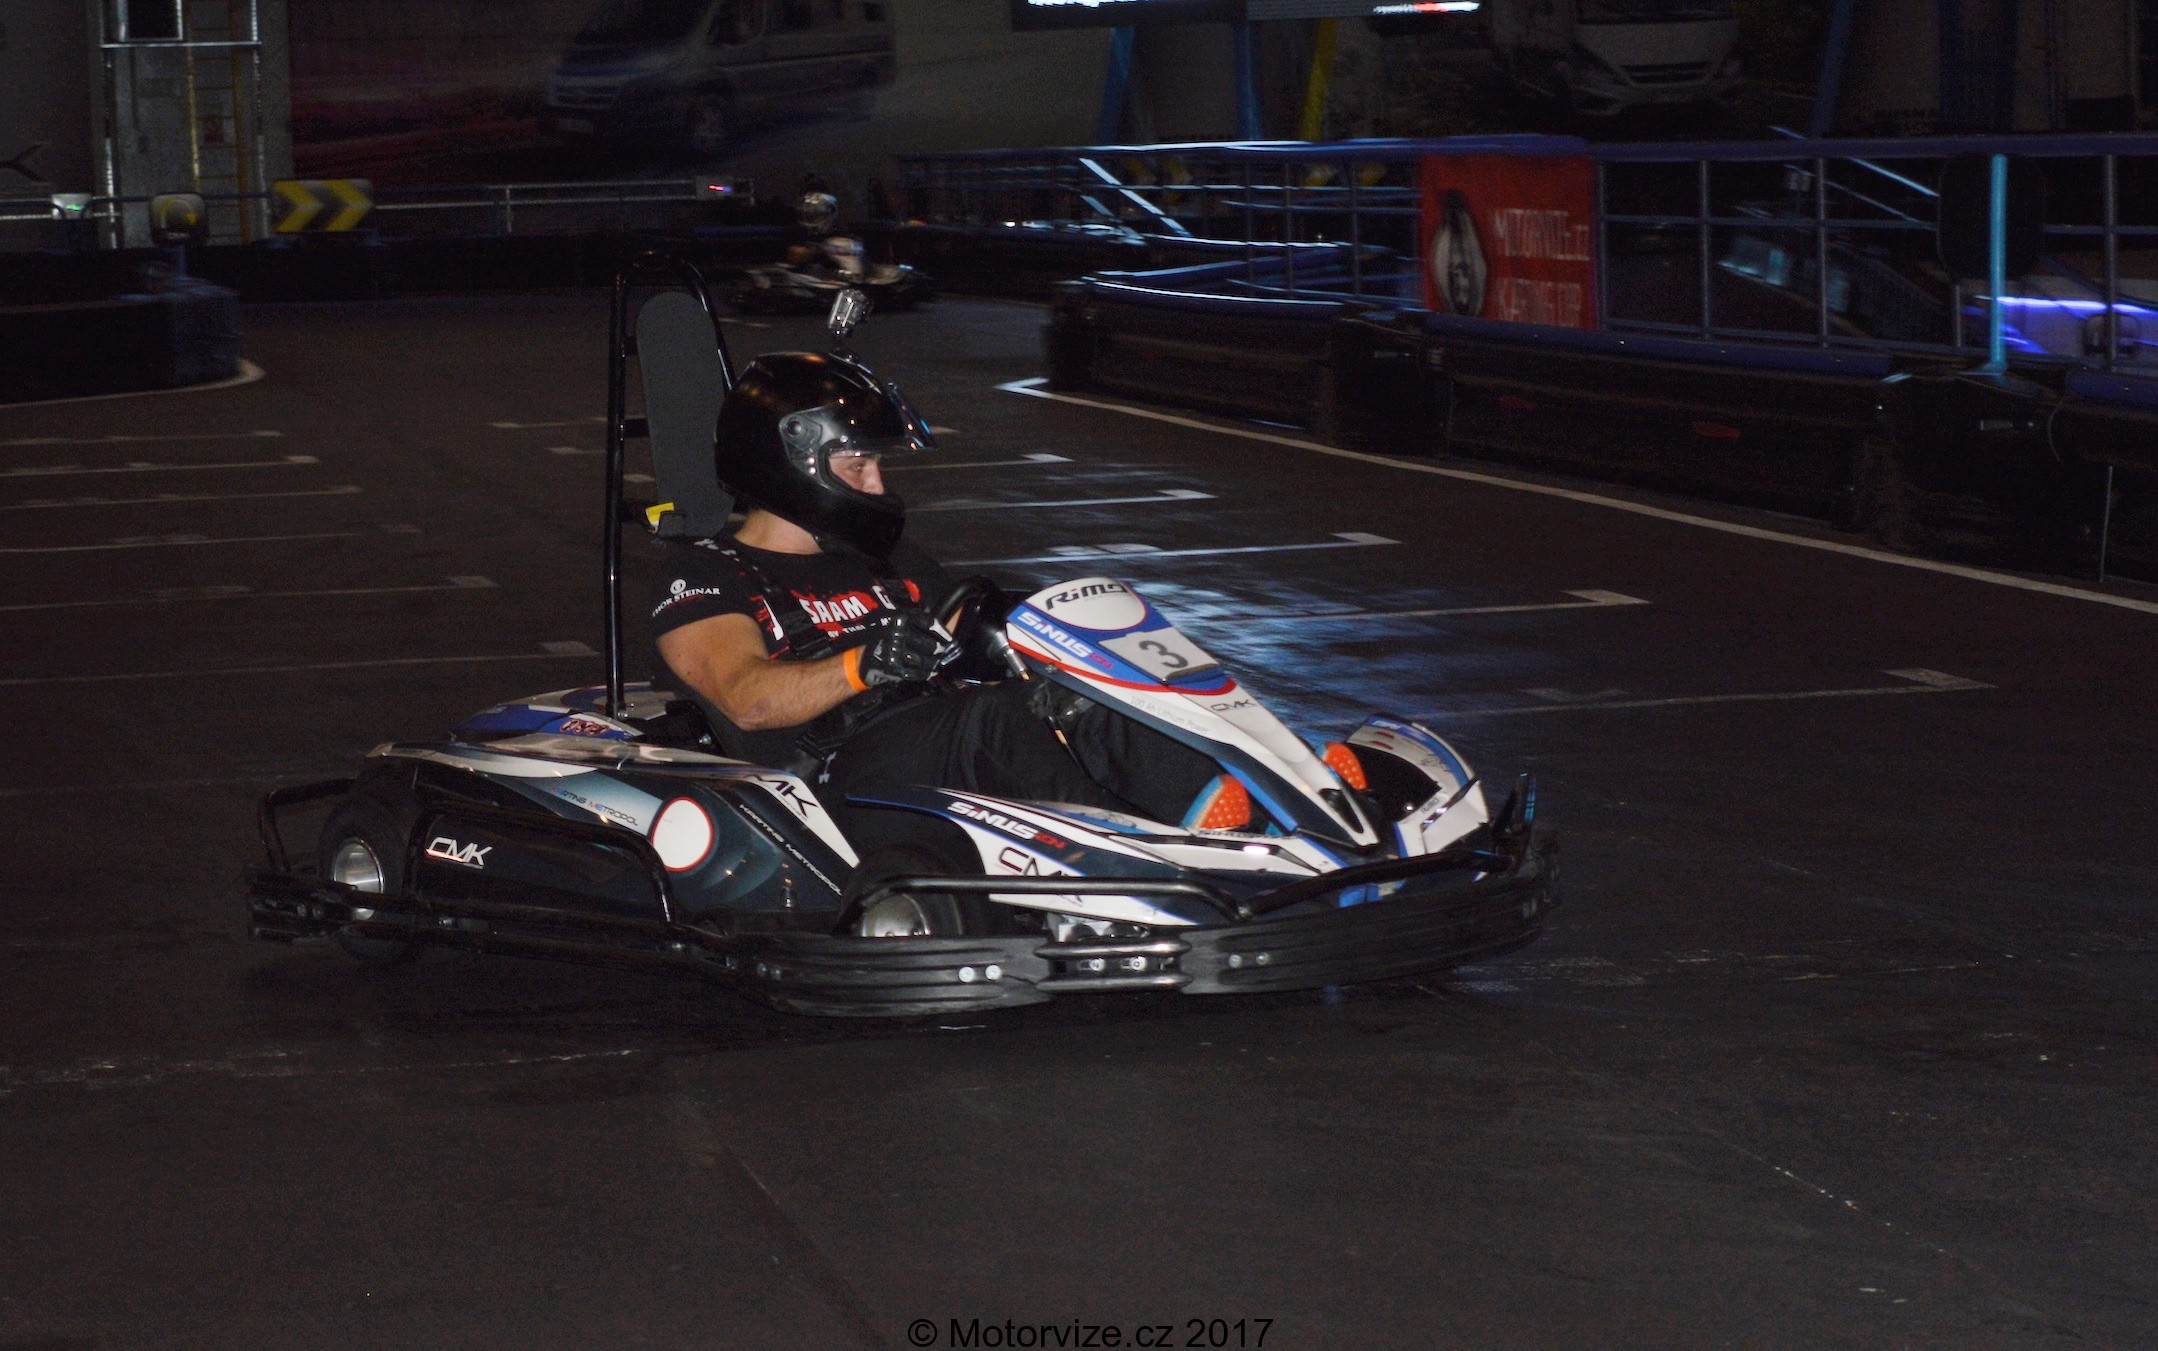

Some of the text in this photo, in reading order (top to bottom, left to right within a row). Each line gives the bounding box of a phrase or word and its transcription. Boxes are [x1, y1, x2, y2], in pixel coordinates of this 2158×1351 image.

[674, 587, 721, 603] STEINAR
[798, 595, 870, 625] SAAM
[1137, 640, 1189, 669] 3
[425, 836, 493, 867] CMK
